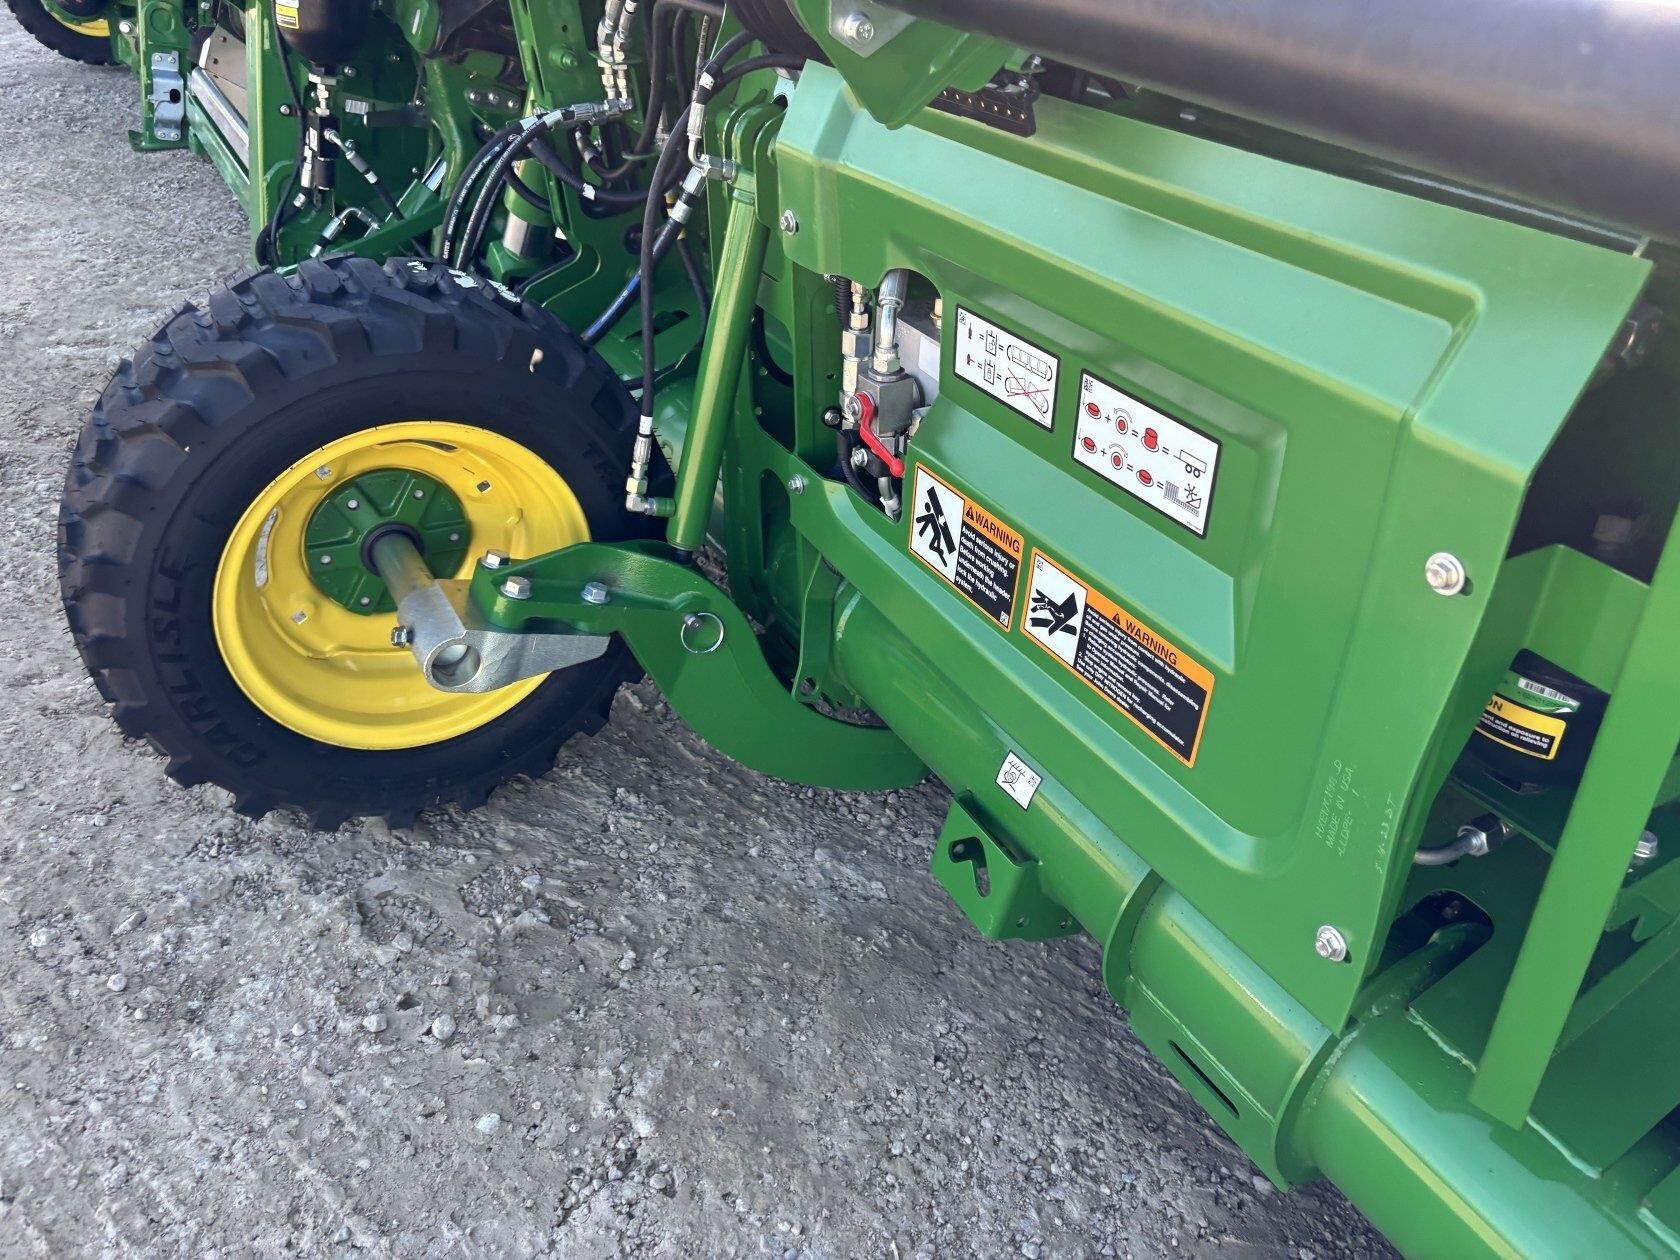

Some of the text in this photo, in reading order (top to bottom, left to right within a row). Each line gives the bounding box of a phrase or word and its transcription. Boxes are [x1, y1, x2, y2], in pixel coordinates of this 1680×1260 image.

[961, 525, 1015, 569] Avoid serious injury or
[975, 510, 1019, 553] WARNING
[958, 555, 984, 580] underneath
[984, 575, 992, 586] the
[959, 544, 994, 578] Before working
[960, 535, 1008, 577] death from crushing.
[956, 563, 997, 601] lock the hydraulic
[1084, 619, 1098, 633] Before
[1091, 618, 1100, 627] and
[1107, 630, 1120, 642] under
[1126, 619, 1177, 665] WARNING
[154, 547, 265, 768] CARLISLE
[1164, 664, 1186, 683] hydraulic
[1107, 674, 1116, 683] and
[1508, 725, 1540, 742] exposure
[1519, 733, 1548, 748] relieving
[1325, 813, 1340, 848] MADE
[1336, 795, 1345, 810] IN
[1341, 767, 1354, 791] USA
